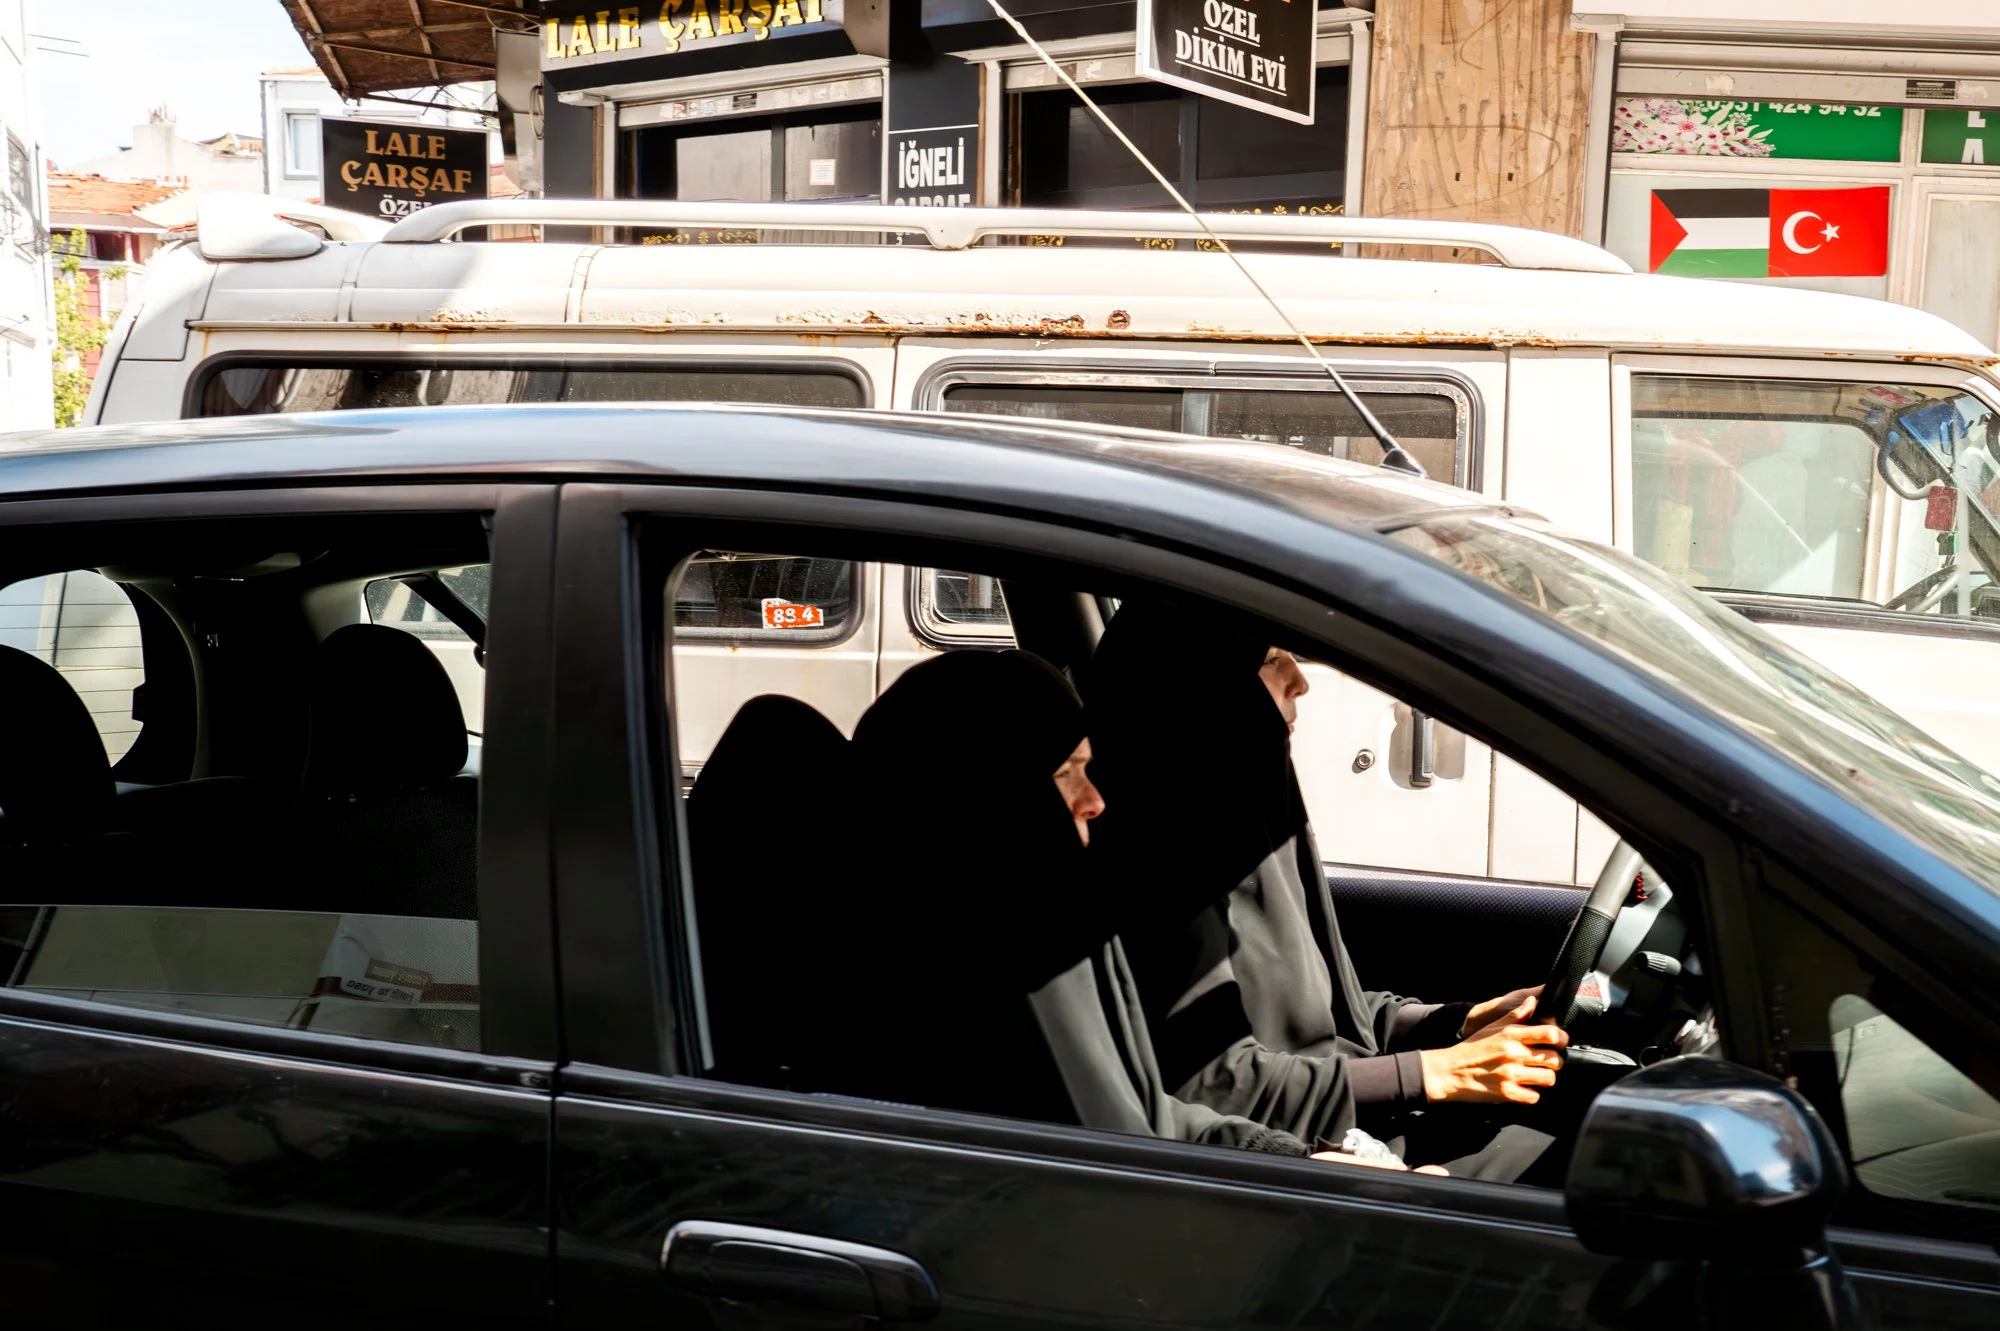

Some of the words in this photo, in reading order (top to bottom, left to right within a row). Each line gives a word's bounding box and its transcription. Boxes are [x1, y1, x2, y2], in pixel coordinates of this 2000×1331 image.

[546, 7, 641, 59] LALE
[1175, 26, 1245, 79] DİKİM
[1251, 55, 1286, 91] EVİ
[365, 130, 446, 160] LALE
[898, 137, 965, 188] İĞNELİ
[340, 160, 472, 197] ÇARŞAF
[379, 194, 432, 216] ÖZE
